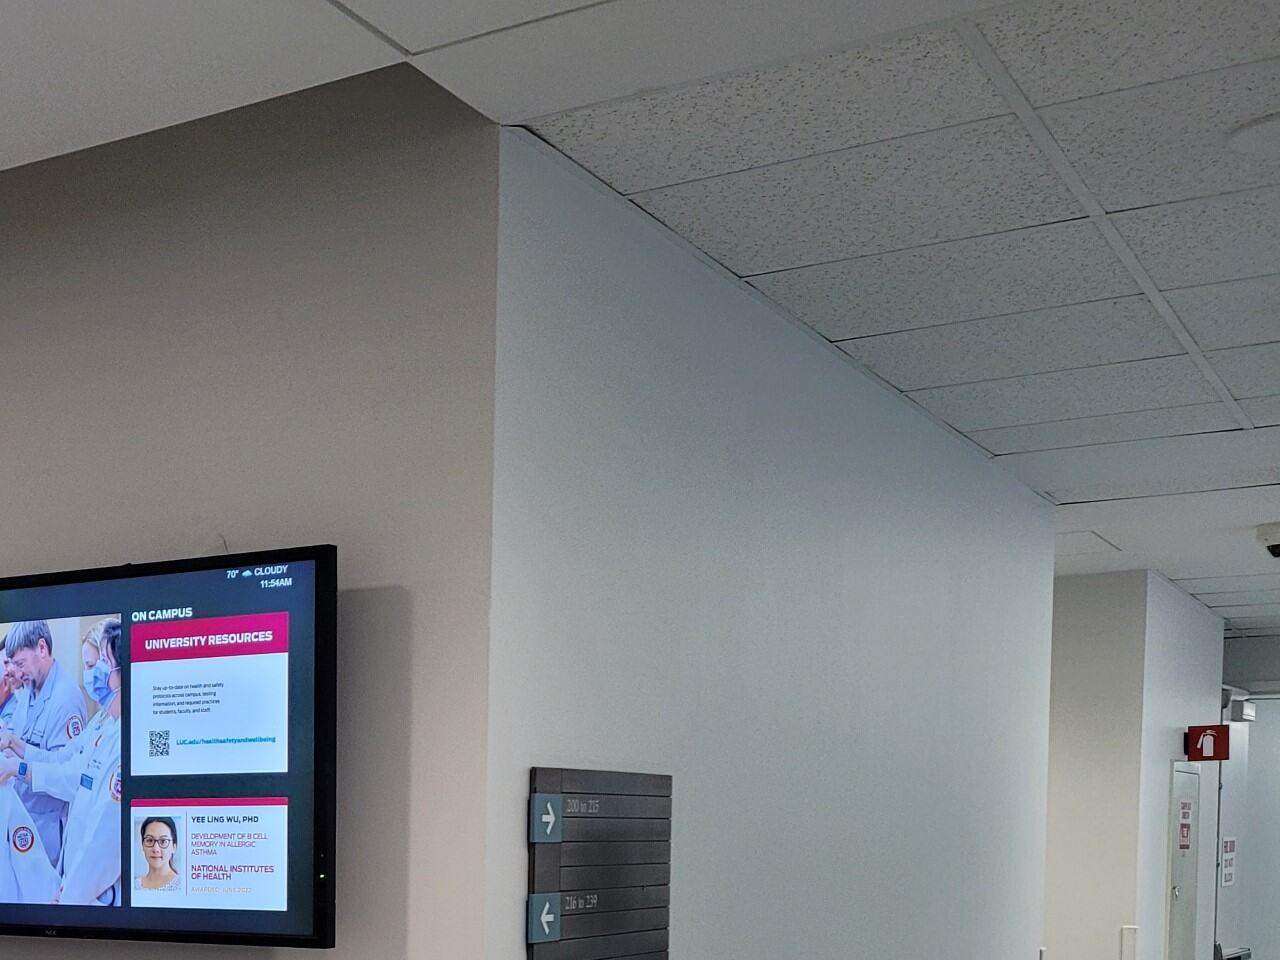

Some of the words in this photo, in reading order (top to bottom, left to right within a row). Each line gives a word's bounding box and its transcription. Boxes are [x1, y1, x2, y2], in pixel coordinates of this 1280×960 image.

[254, 565, 289, 576] CLOUDY
[260, 578, 293, 588] 11:54AM
[131, 610, 147, 622] ON
[148, 607, 193, 620] CAMPUS
[144, 635, 207, 650] UNIVERSITY
[208, 631, 273, 646] RESOURCES
[226, 816, 241, 824] WU,
[230, 865, 274, 873] INSTITUTES
